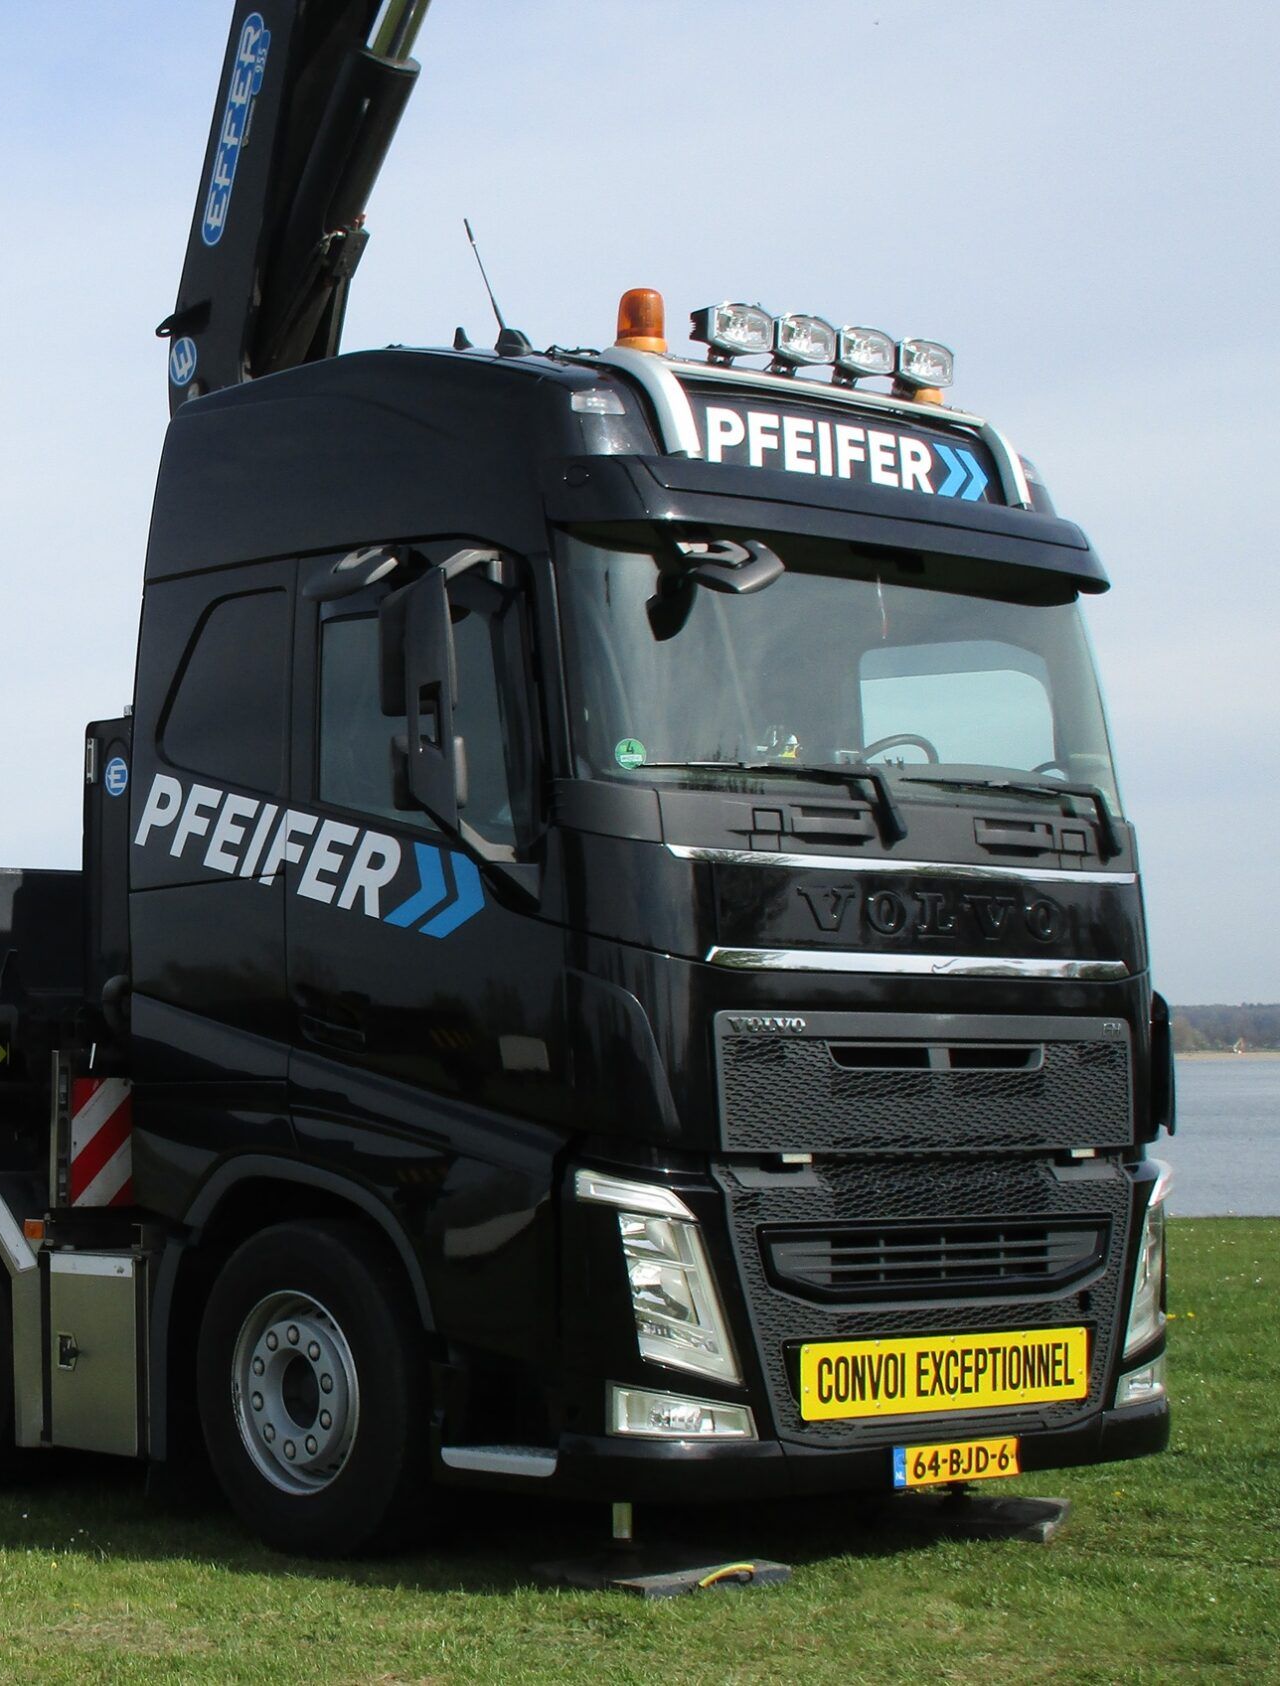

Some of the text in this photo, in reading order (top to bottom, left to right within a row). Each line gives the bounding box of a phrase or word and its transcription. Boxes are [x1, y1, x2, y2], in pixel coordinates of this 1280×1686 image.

[207, 26, 262, 230] EFFER
[705, 407, 934, 495] PFEIFER
[626, 741, 635, 755] 4
[134, 773, 402, 919] PFEIFER
[797, 885, 1066, 944] VOLVO
[727, 1016, 807, 1034] VOLVO
[817, 1342, 1075, 1404] CONVOI EXCEPTIONNEL
[913, 1443, 1010, 1479] 64-BJD-6
